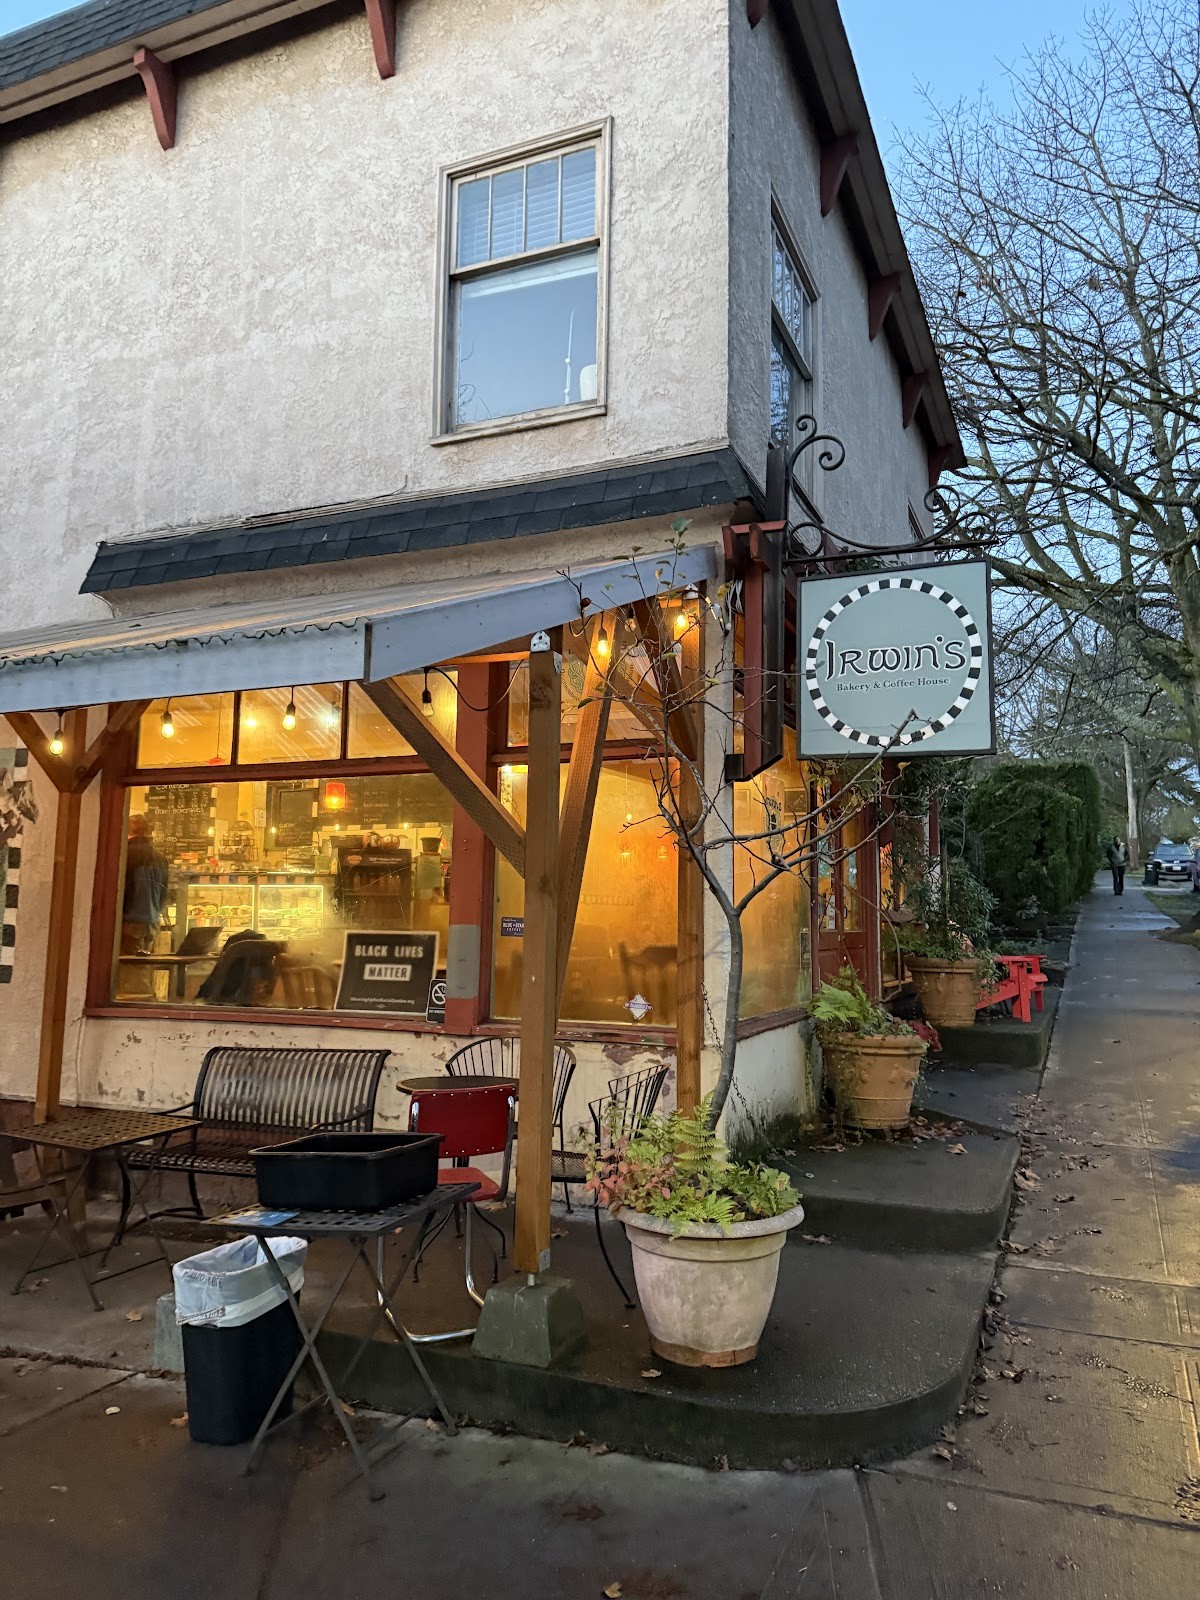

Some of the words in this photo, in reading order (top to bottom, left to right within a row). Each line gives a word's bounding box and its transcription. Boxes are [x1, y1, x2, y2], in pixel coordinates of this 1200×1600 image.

[836, 683, 870, 692] Bakery
[873, 680, 881, 689] &
[883, 678, 914, 688] Coffee
[918, 676, 949, 686] House
[355, 945, 388, 957] BLACK
[394, 946, 424, 958] LIVES
[367, 966, 408, 979] MATTER
